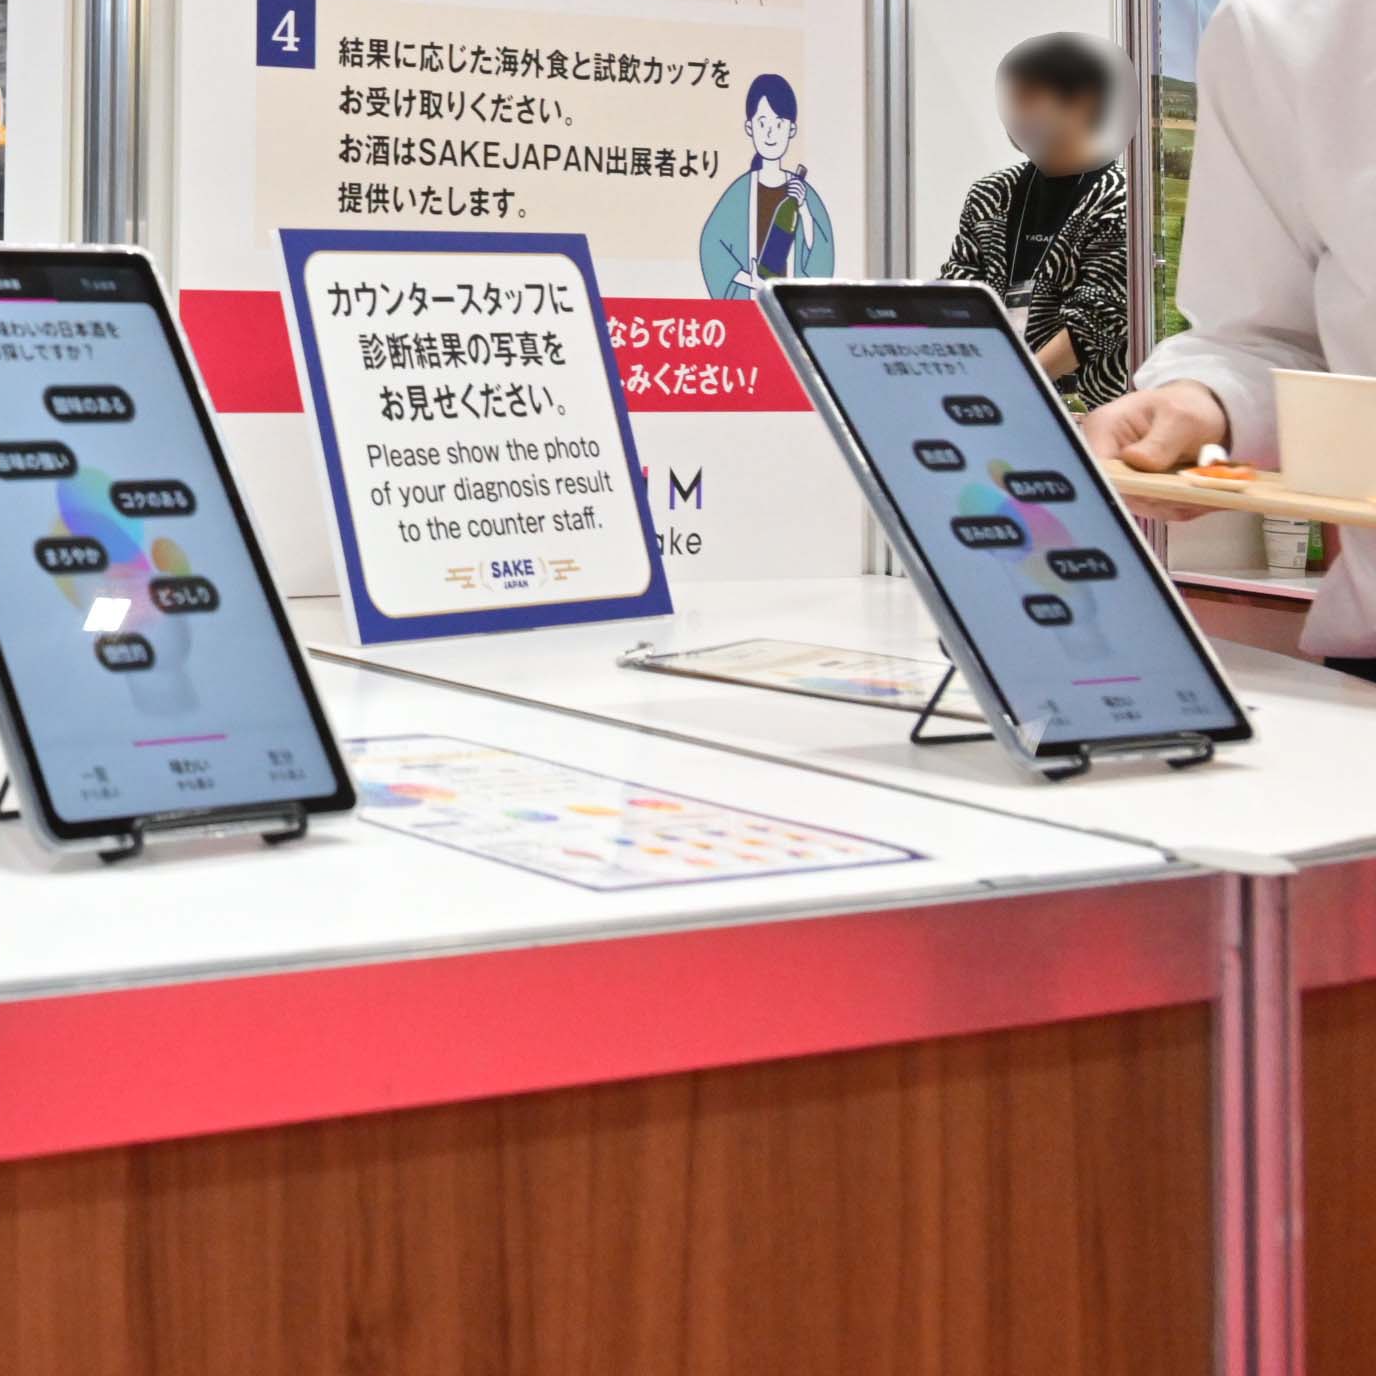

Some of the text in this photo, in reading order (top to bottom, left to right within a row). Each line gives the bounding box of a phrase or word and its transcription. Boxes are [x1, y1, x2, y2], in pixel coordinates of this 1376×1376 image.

[272, 10, 301, 52] 4
[338, 36, 731, 89] 結果に応じた海外食と試飲カップを
[338, 85, 574, 127] お受け取りください。
[338, 134, 720, 179] お酒はSAKEJAPAN出展者より
[338, 181, 527, 219] 提供いたします。
[327, 281, 574, 318] カウンタースタッフに
[359, 331, 567, 372] 診断結果の写真を
[379, 383, 566, 423] お見せください。
[367, 436, 600, 468] Please show the photo
[371, 481, 392, 506] of
[398, 482, 446, 508] your
[453, 474, 550, 503] diagnosis
[556, 470, 614, 495] result
[398, 505, 603, 543] to the counter staff.
[491, 559, 535, 579] SAKE
